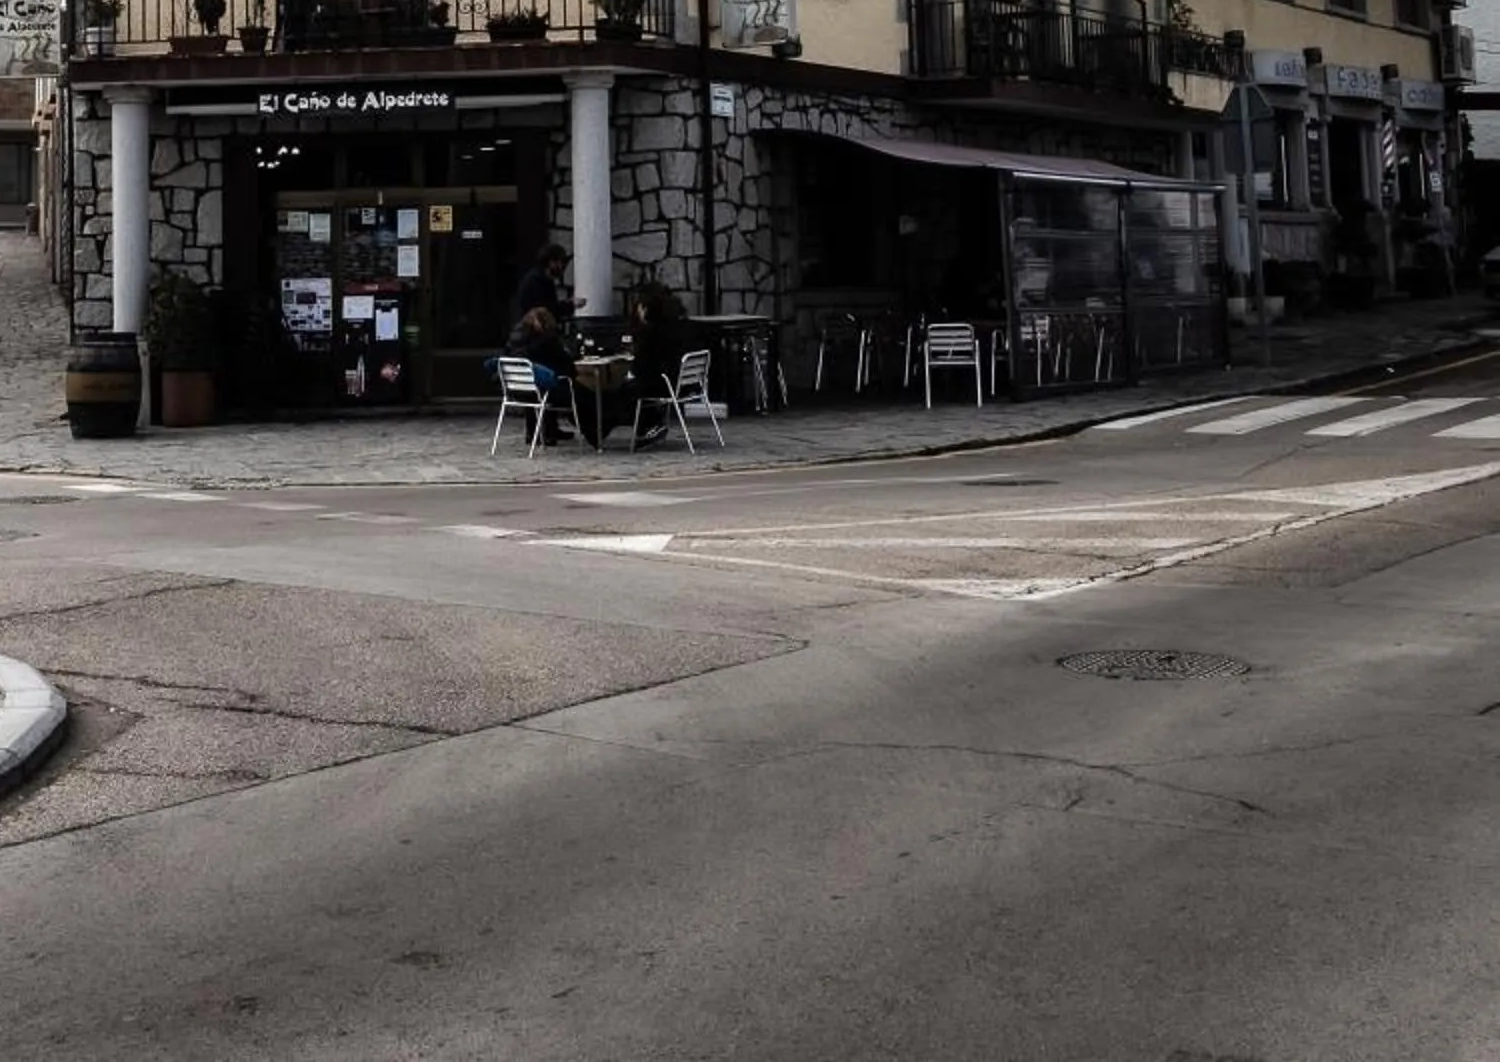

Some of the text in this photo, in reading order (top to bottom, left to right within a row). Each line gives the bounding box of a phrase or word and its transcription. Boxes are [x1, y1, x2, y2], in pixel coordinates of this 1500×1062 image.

[259, 90, 450, 113] El Caño de Alpedrete
